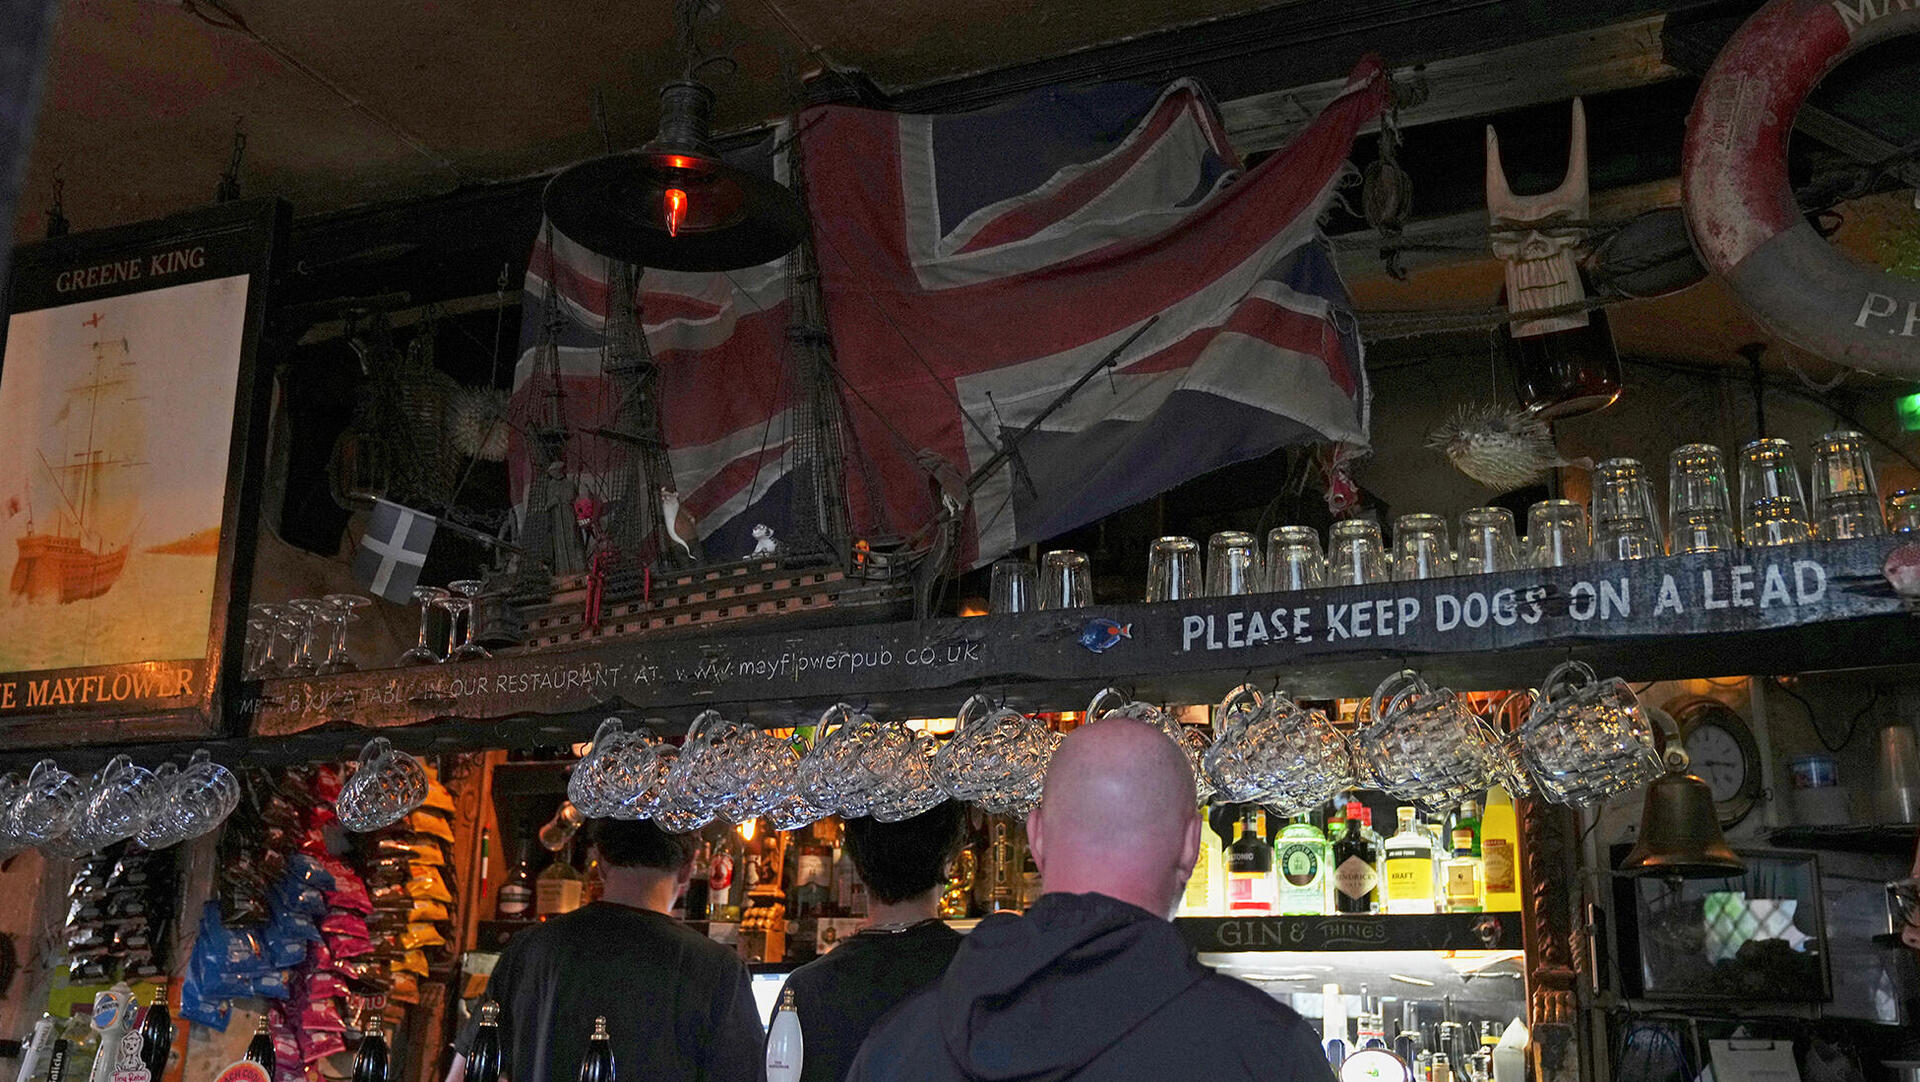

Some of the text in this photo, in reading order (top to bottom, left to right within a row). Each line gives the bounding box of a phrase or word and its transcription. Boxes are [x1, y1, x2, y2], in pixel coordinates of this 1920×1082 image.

[56, 247, 206, 293] GREENE KING
[1183, 560, 1826, 651] PLEASE KEEP DOGS ON A LEAD
[26, 668, 193, 708] MAYFLOWER
[449, 676, 489, 697] OUR
[496, 667, 620, 694] RESTAURANT
[634, 666, 660, 684] AT
[1216, 920, 1386, 947] GIN & THINGS
